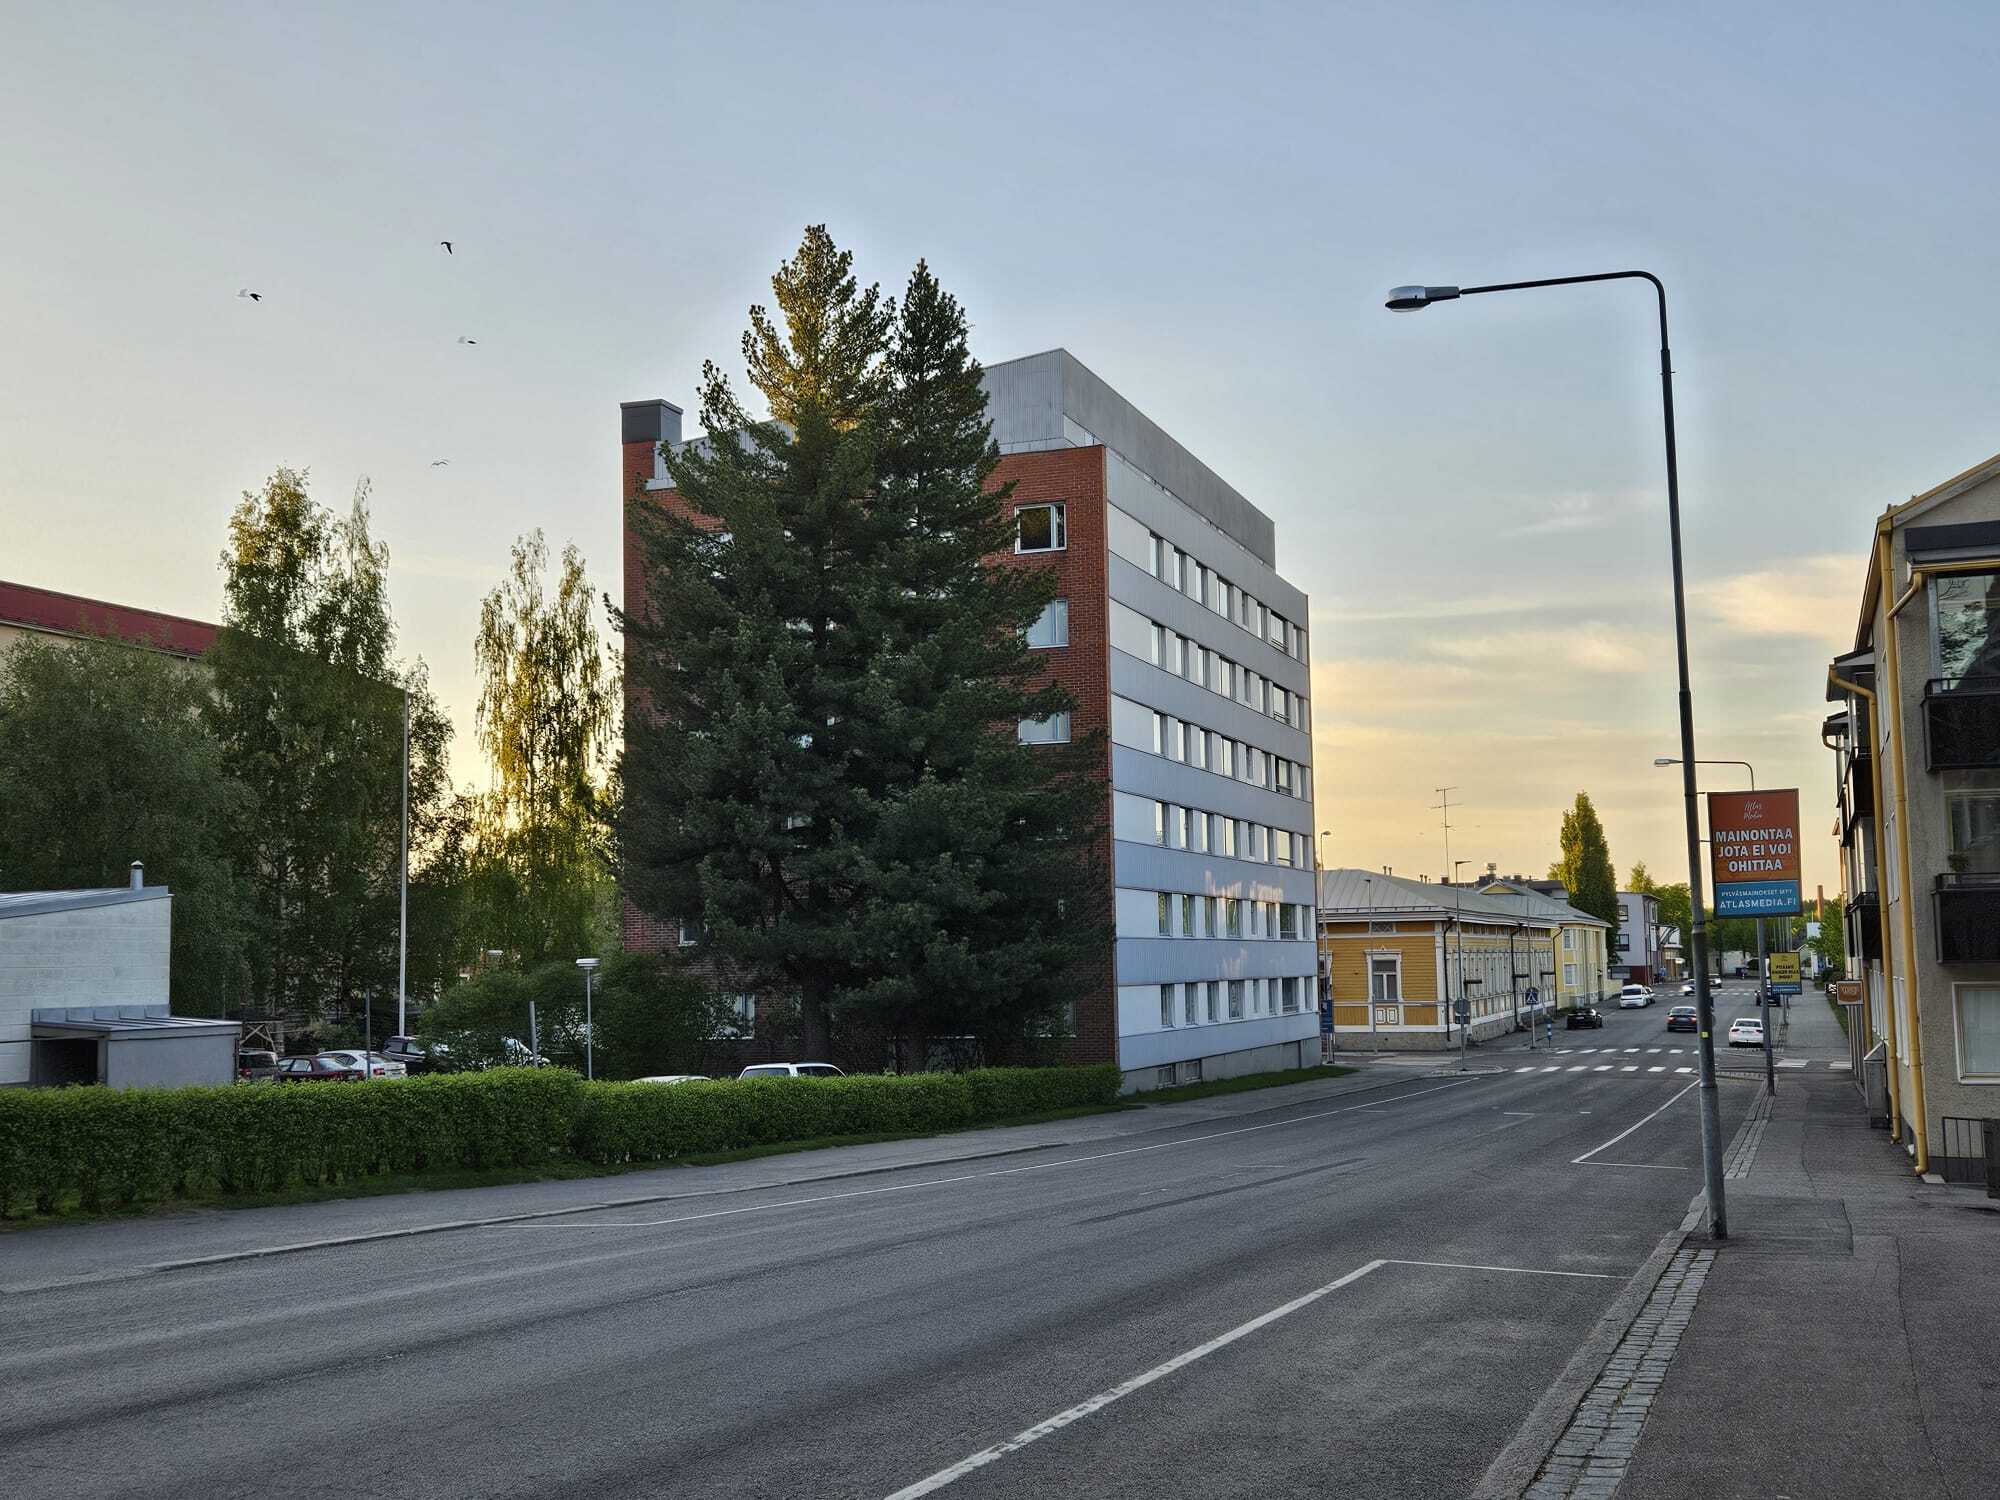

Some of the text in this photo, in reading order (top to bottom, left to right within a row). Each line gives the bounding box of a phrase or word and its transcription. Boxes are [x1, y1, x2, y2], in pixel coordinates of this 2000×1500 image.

[1716, 828, 1793, 842] MAINONTAA
[1718, 844, 1791, 857] JOTA EI VOI
[1728, 859, 1782, 872] OHITTAA
[1720, 898, 1796, 909] ATLASMEDIA.FI
